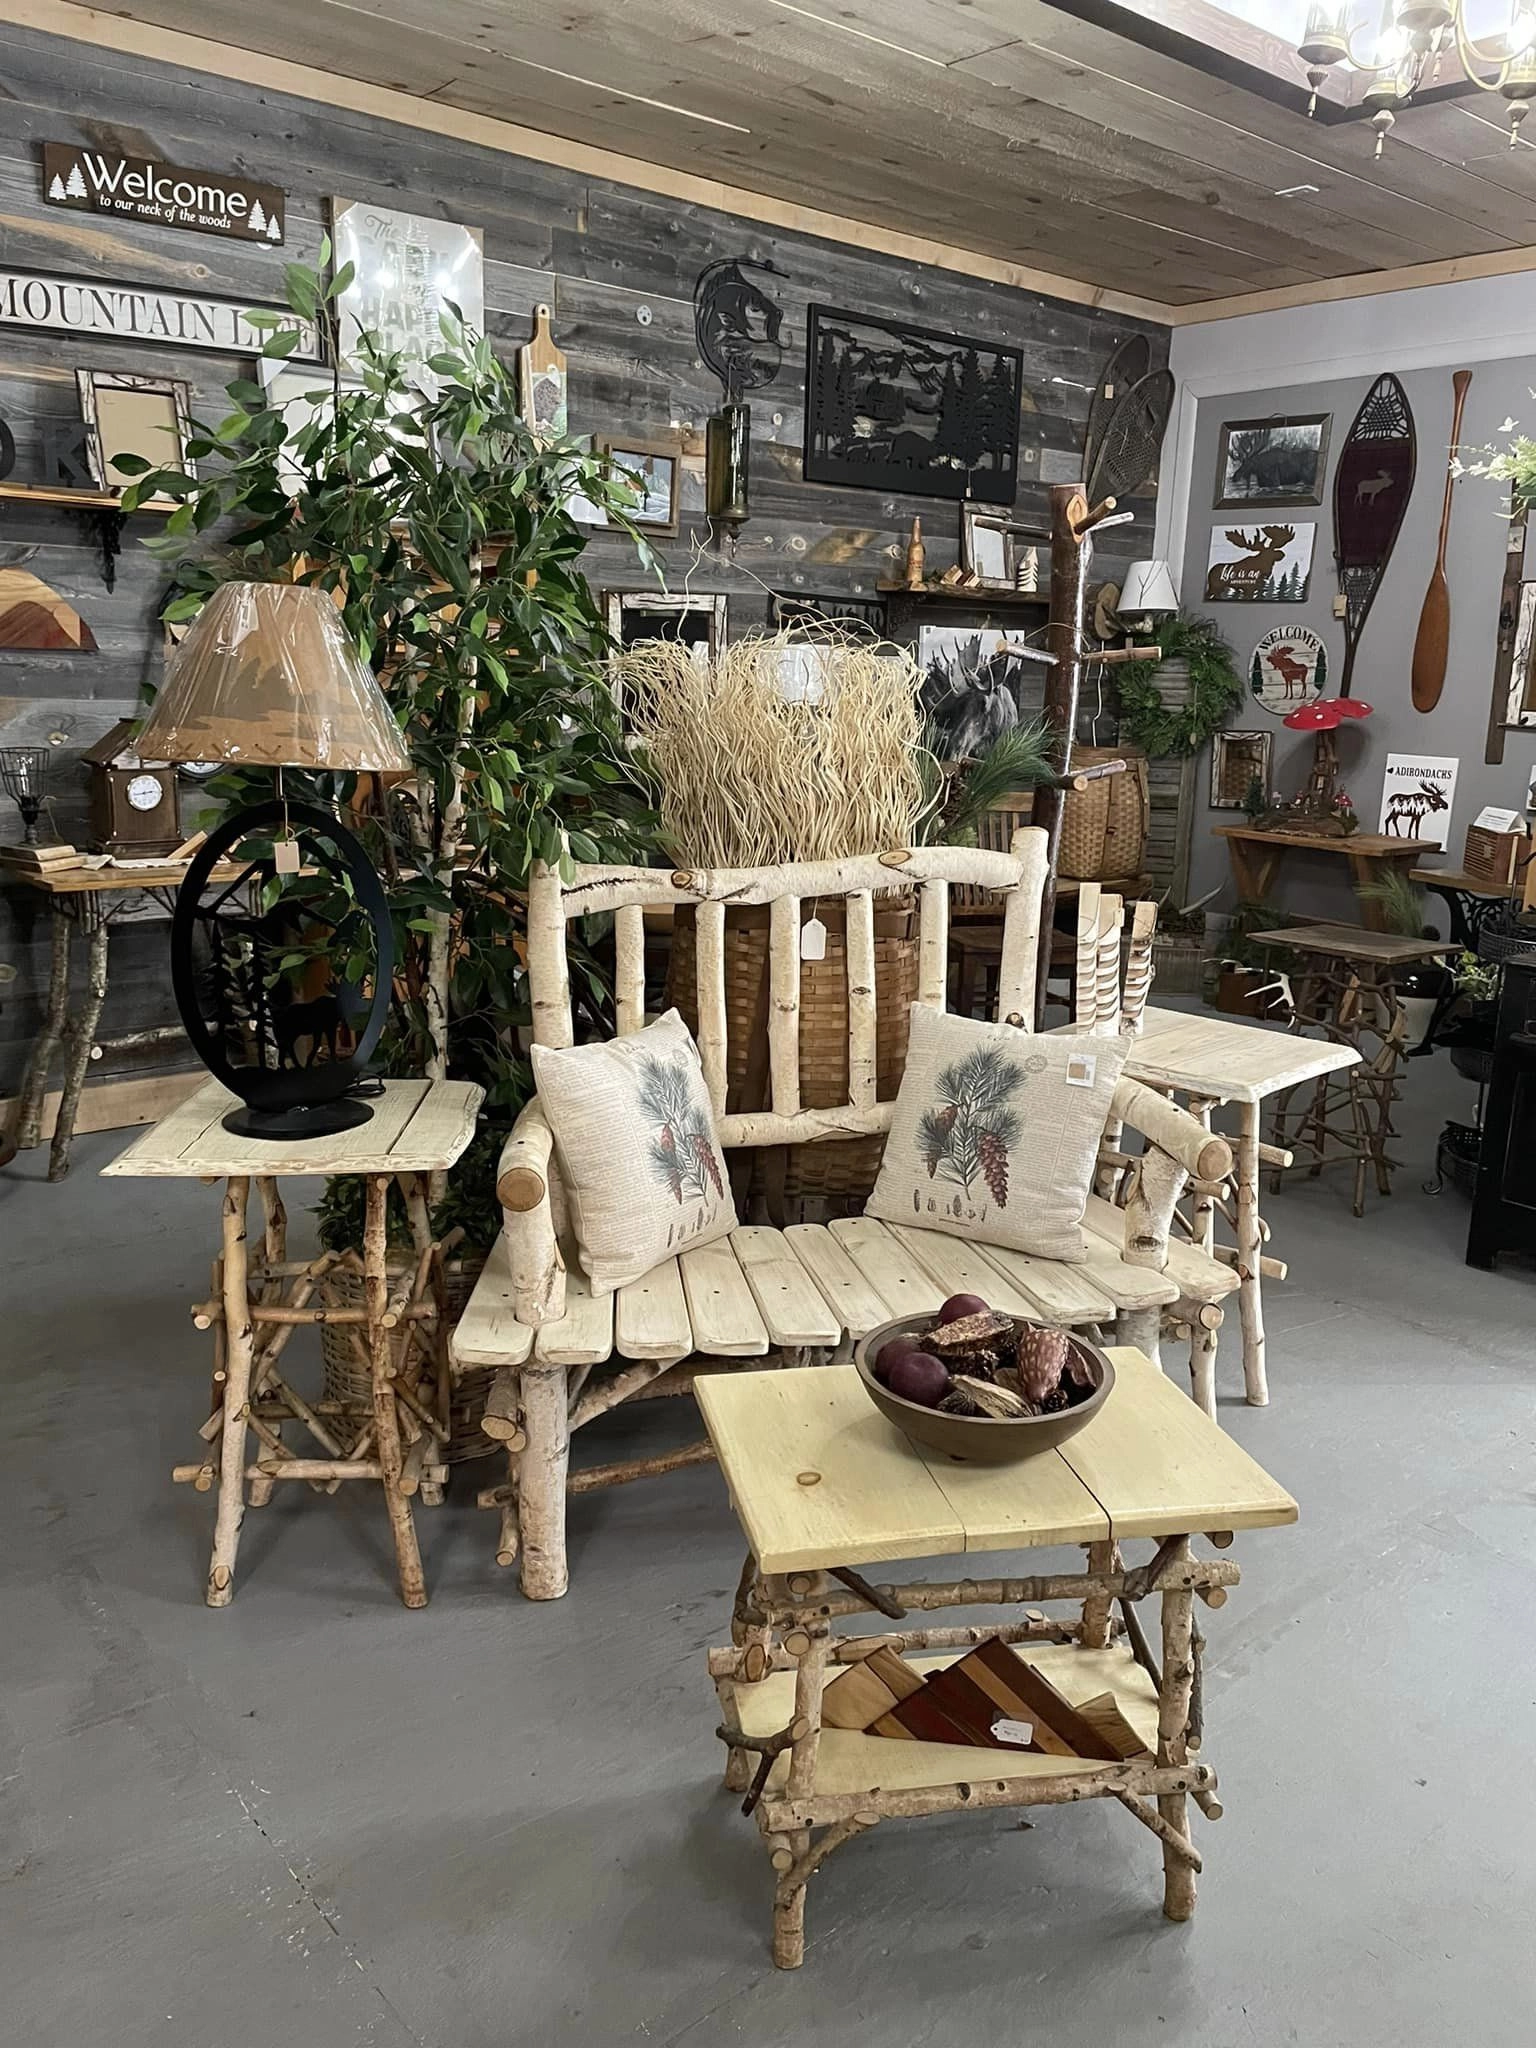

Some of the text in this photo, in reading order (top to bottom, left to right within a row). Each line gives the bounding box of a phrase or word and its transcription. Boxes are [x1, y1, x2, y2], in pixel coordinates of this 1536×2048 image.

[82, 152, 248, 217] Welcome
[100, 194, 231, 229] to our neck of the woods
[1220, 565, 1260, 581] Life is an
[1258, 626, 1320, 652] WELCOME
